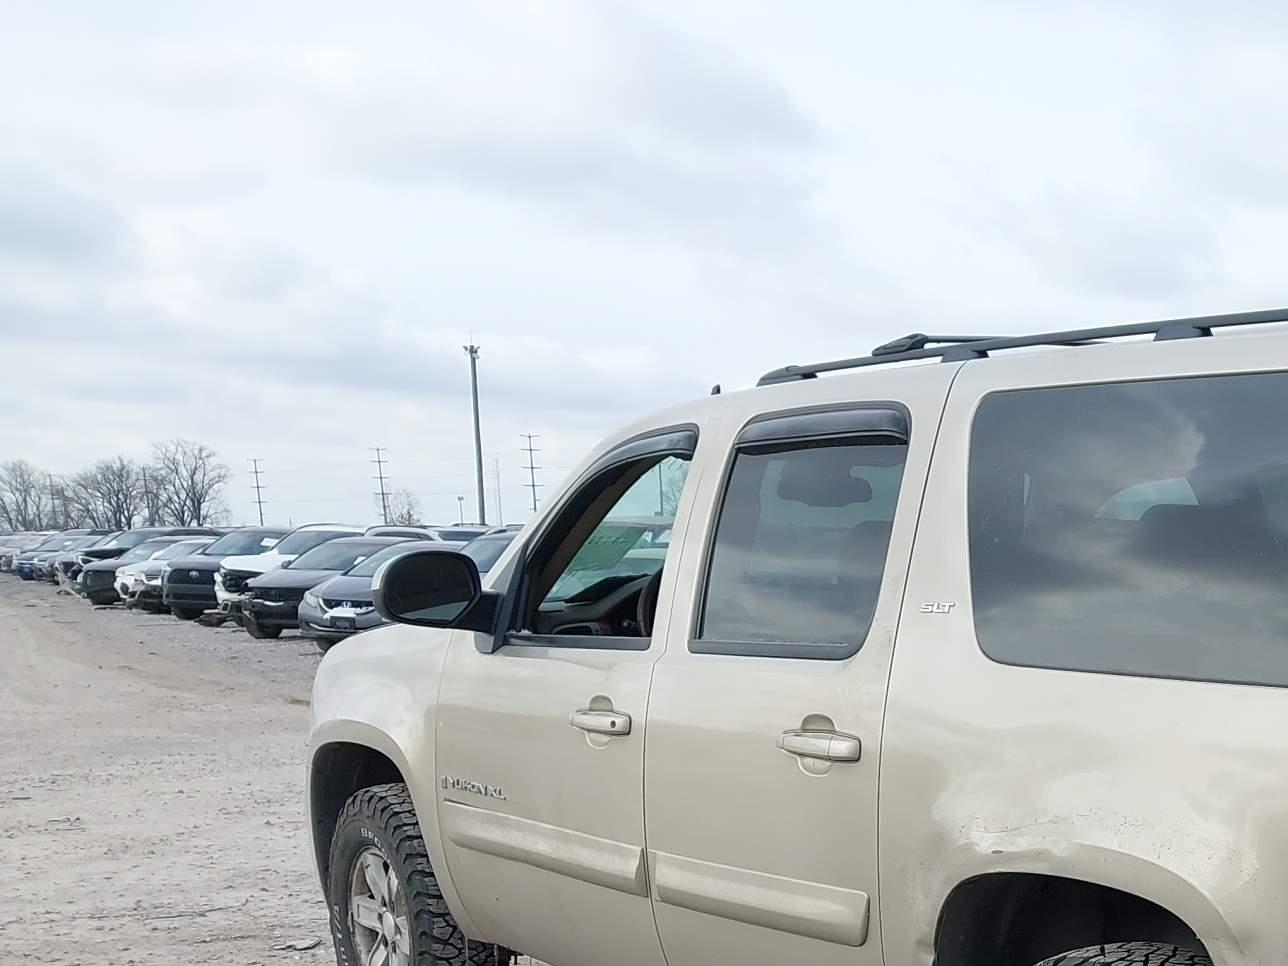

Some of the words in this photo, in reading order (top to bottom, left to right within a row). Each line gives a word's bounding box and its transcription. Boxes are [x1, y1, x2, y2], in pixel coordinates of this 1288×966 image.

[919, 601, 956, 614] SLT
[447, 776, 488, 796] YUKON
[489, 785, 507, 800] XL
